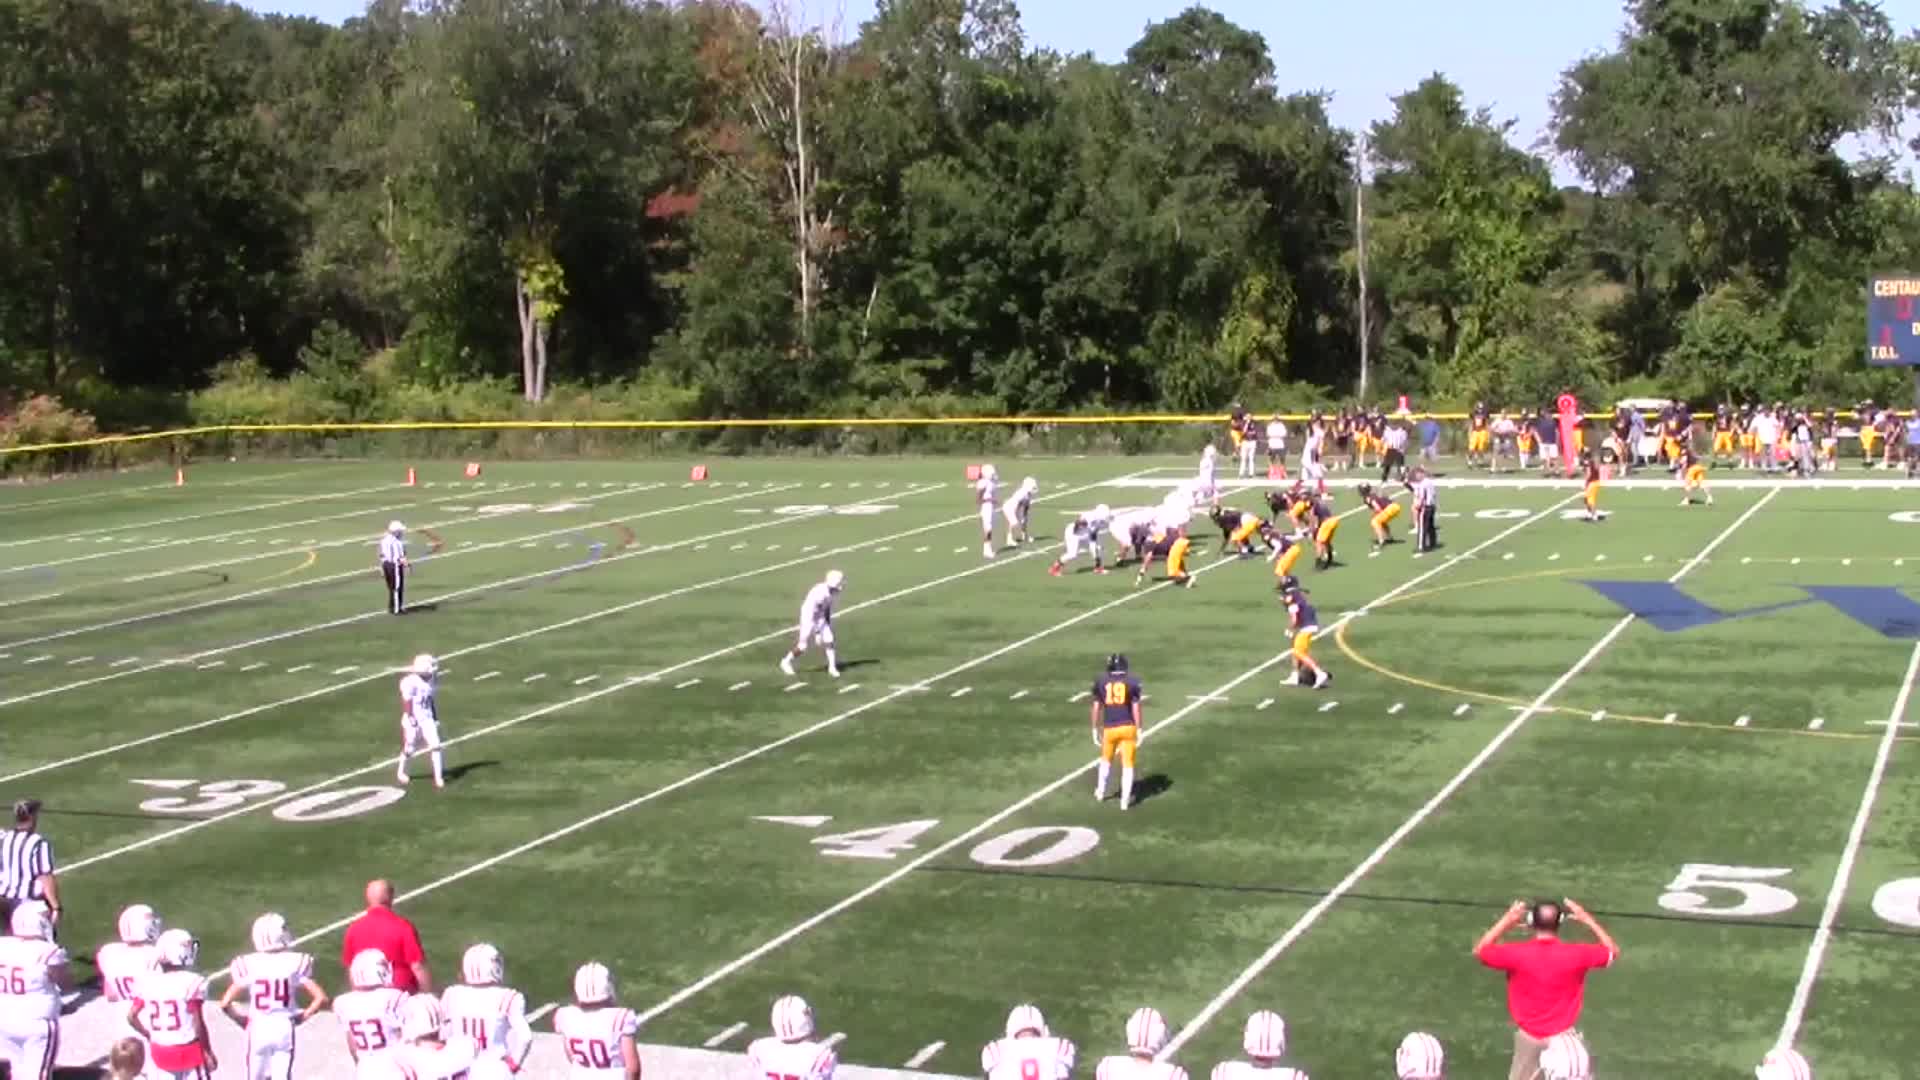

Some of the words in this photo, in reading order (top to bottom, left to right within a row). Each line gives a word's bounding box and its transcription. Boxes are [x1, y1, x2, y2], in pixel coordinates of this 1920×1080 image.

[1104, 682, 1127, 705] 19
[138, 779, 407, 822] 30
[809, 819, 1101, 866] 40
[254, 979, 290, 1010] 24
[149, 1000, 181, 1031] 23
[349, 1019, 387, 1051] 53
[462, 1016, 488, 1051] 14
[569, 1039, 612, 1069] 50
